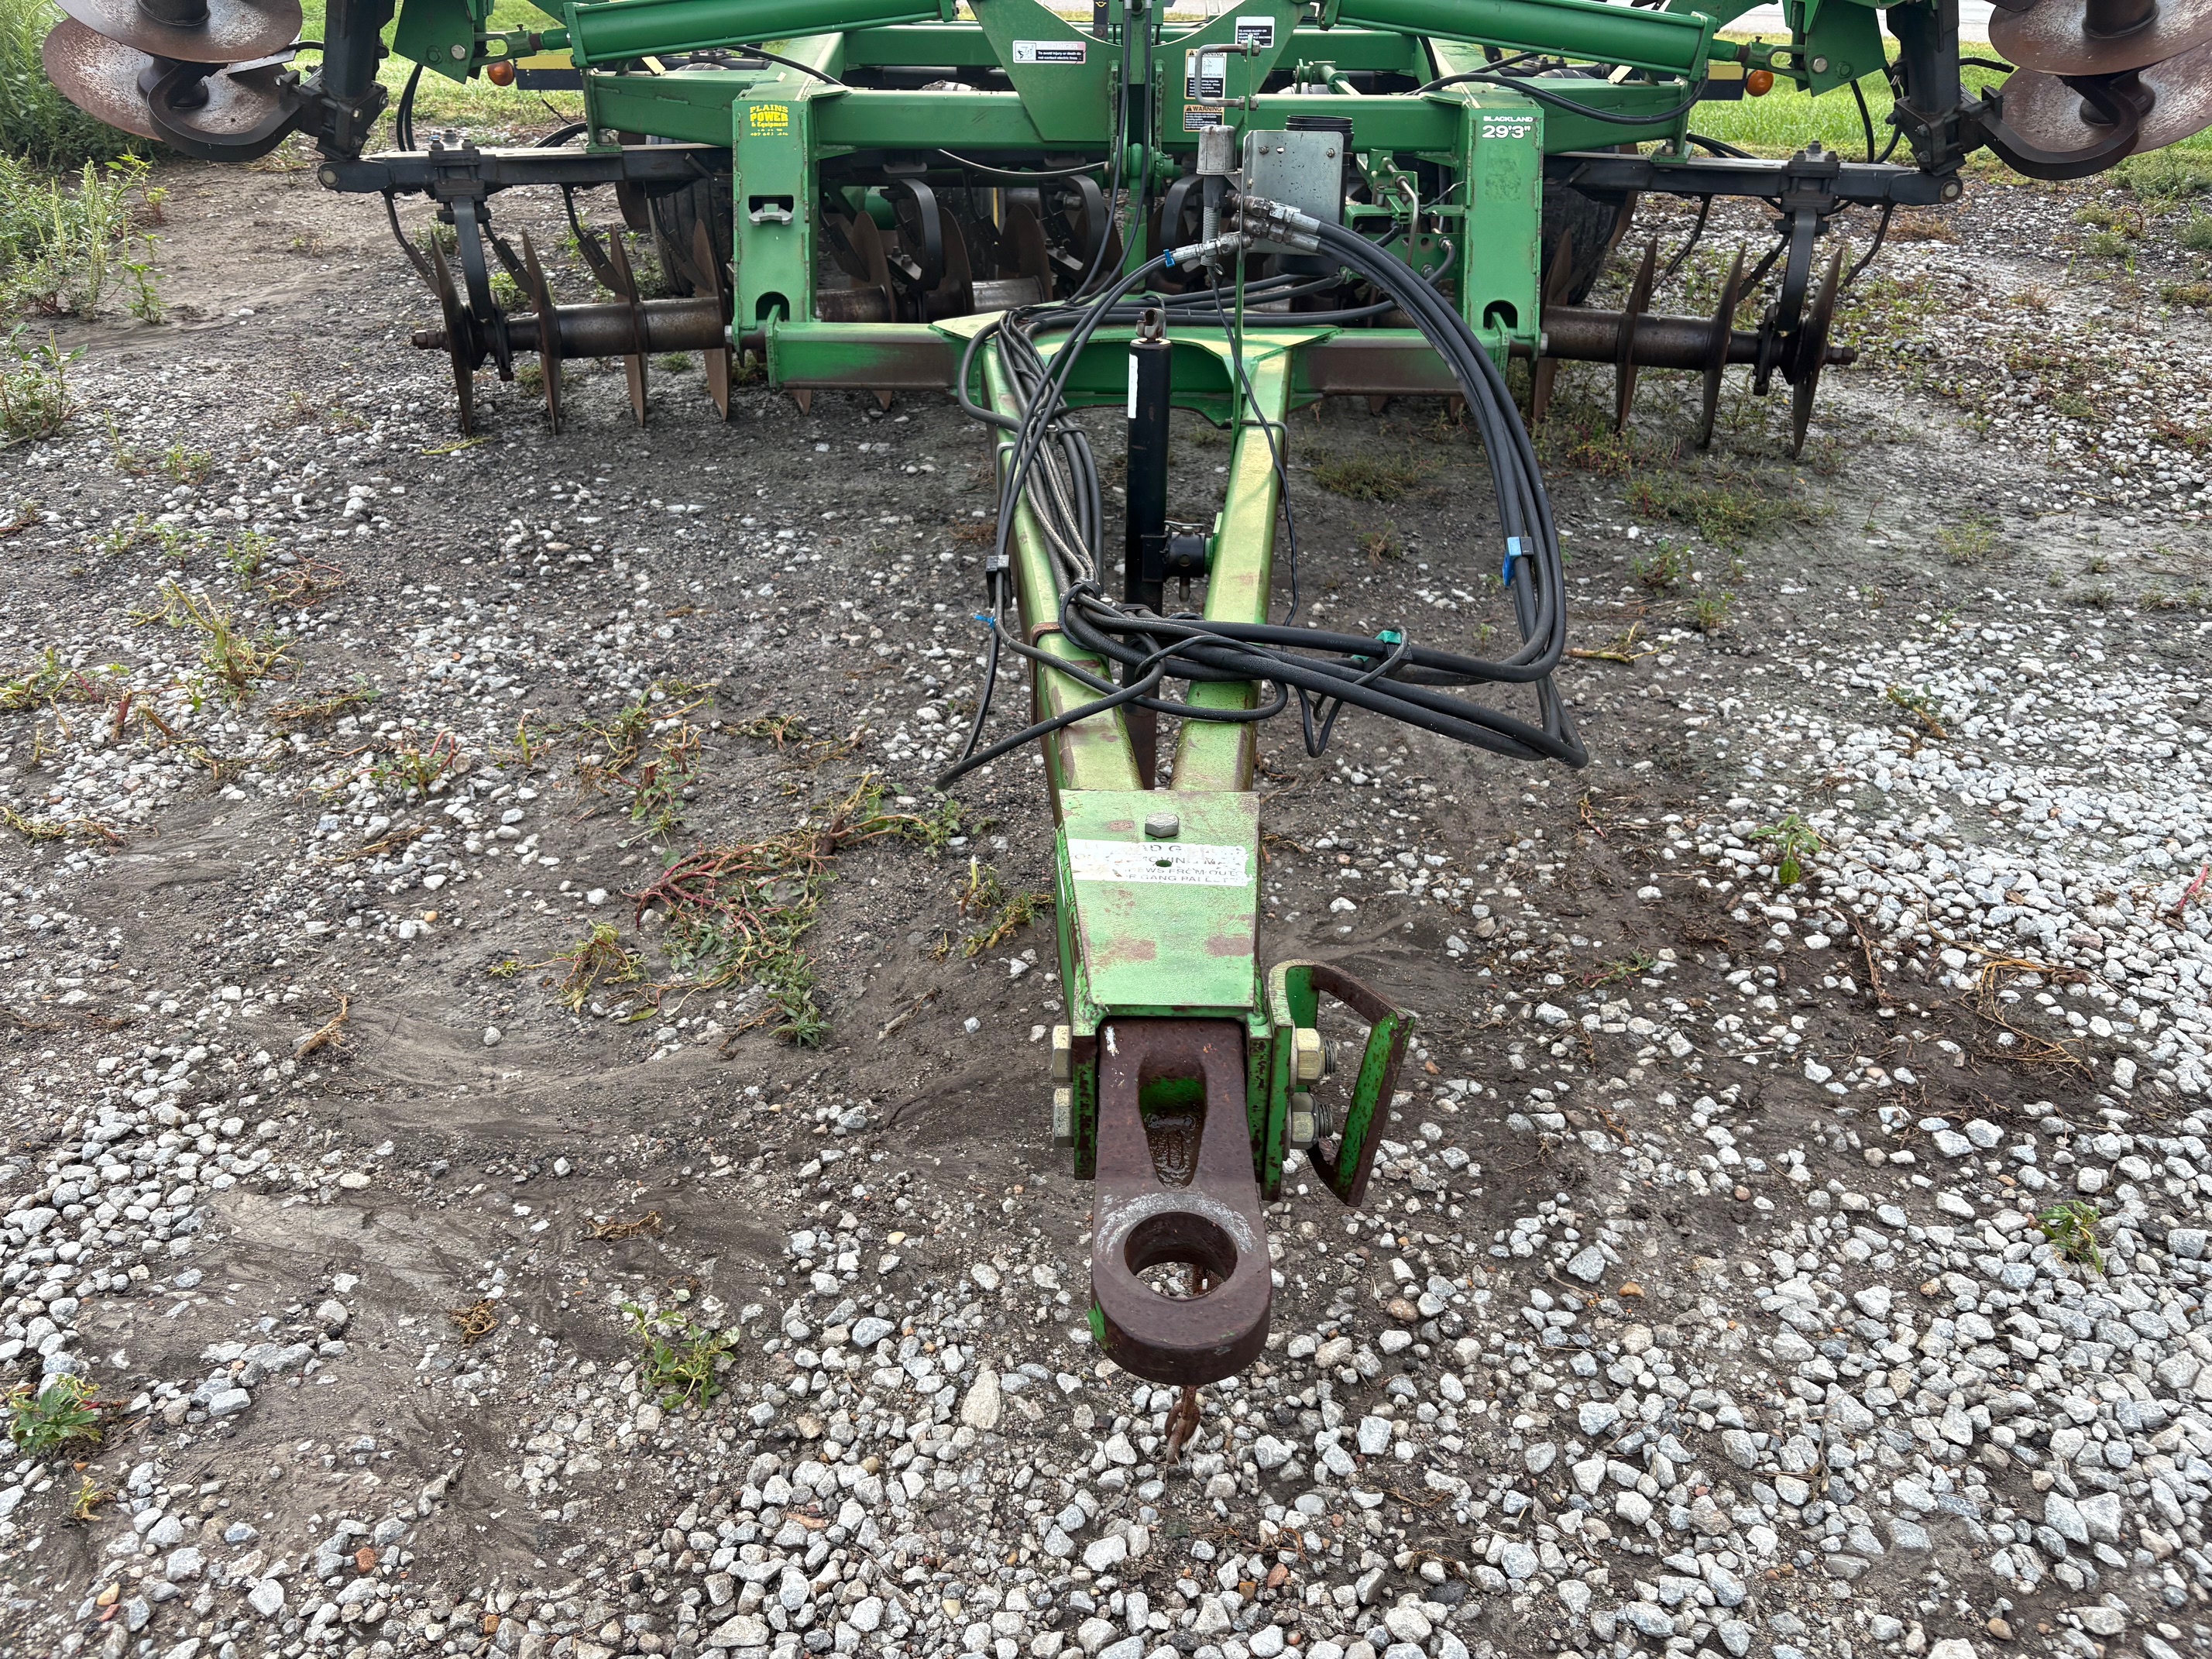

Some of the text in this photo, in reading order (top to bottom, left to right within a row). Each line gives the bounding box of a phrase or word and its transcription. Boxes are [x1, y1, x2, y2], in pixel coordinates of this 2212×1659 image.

[750, 105, 788, 113] PLAINS
[750, 111, 788, 122] POWER
[1482, 125, 1531, 139] 29'3"
